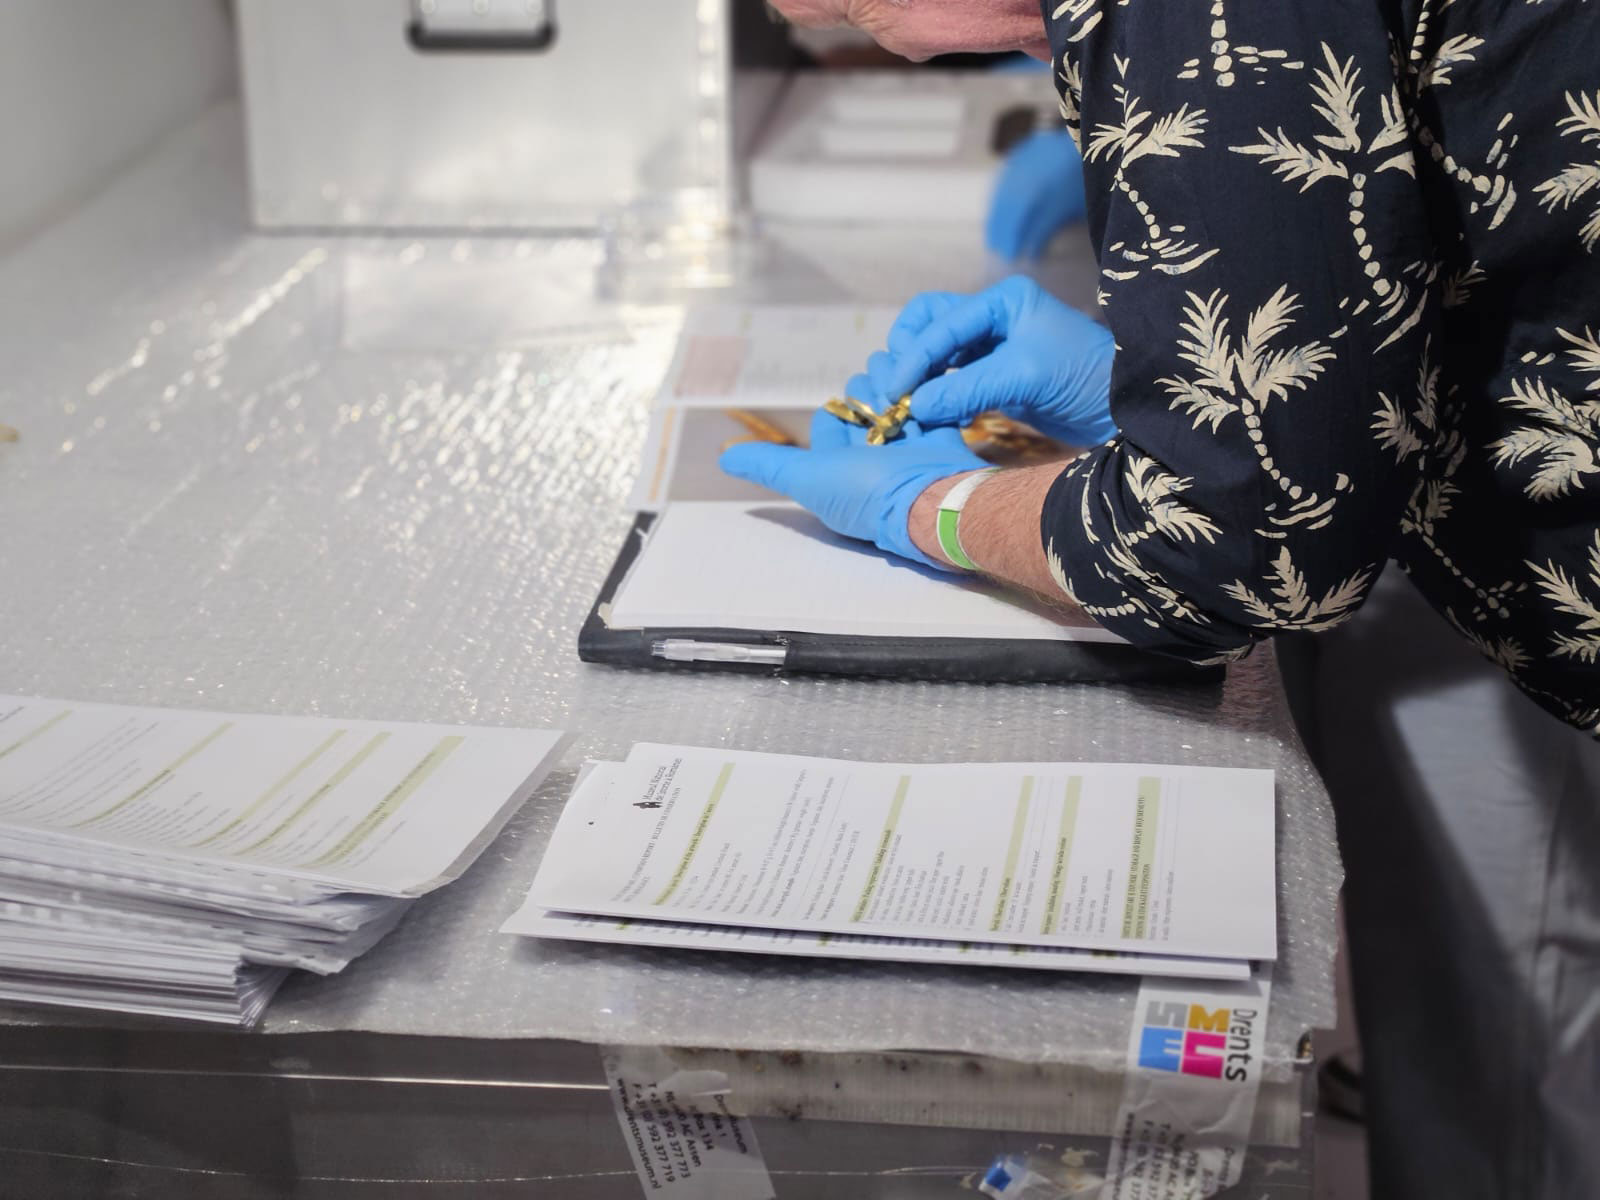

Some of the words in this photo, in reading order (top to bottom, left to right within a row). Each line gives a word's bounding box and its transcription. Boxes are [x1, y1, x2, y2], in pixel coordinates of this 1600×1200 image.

[1225, 1008, 1258, 1082] Drents
[647, 1123, 662, 1143] 592
[662, 1120, 677, 1139] 592
[680, 1122, 694, 1137] AC
[654, 1144, 669, 1162] 377
[670, 1140, 685, 1158] 377
[686, 1139, 702, 1167] Assen
[662, 1165, 677, 1183] 719
[677, 1160, 692, 1179] 773
